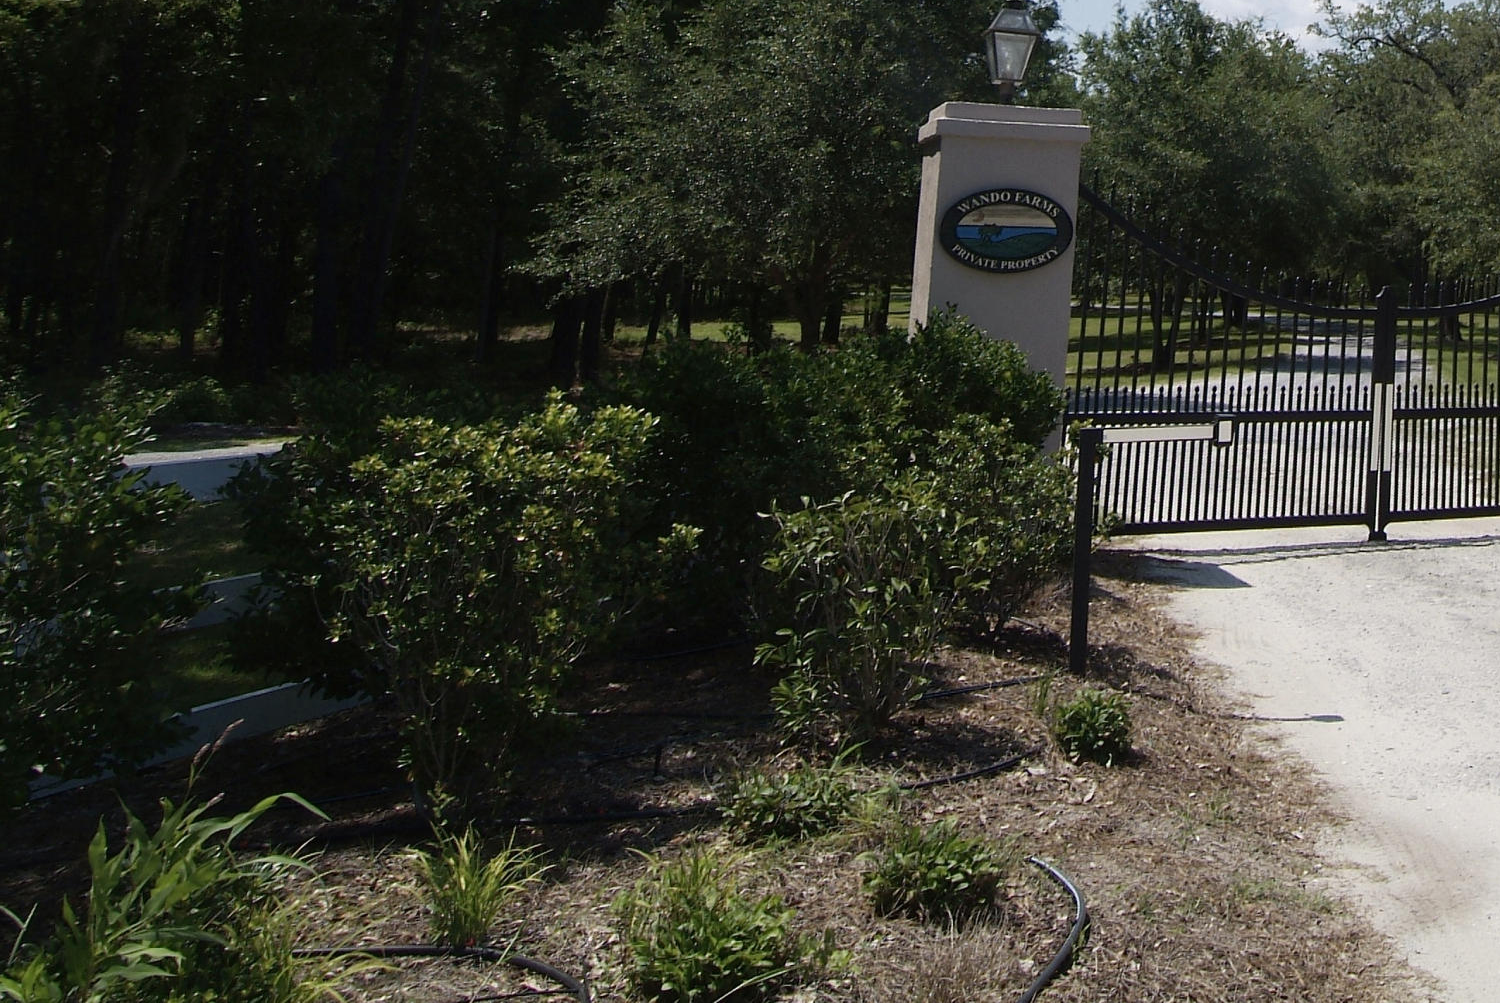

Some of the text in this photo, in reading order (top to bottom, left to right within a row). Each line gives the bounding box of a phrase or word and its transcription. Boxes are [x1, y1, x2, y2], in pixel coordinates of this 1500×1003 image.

[957, 191, 1061, 218] WANDO FARMS
[952, 244, 1059, 270] PRIVATE PROPERTY
